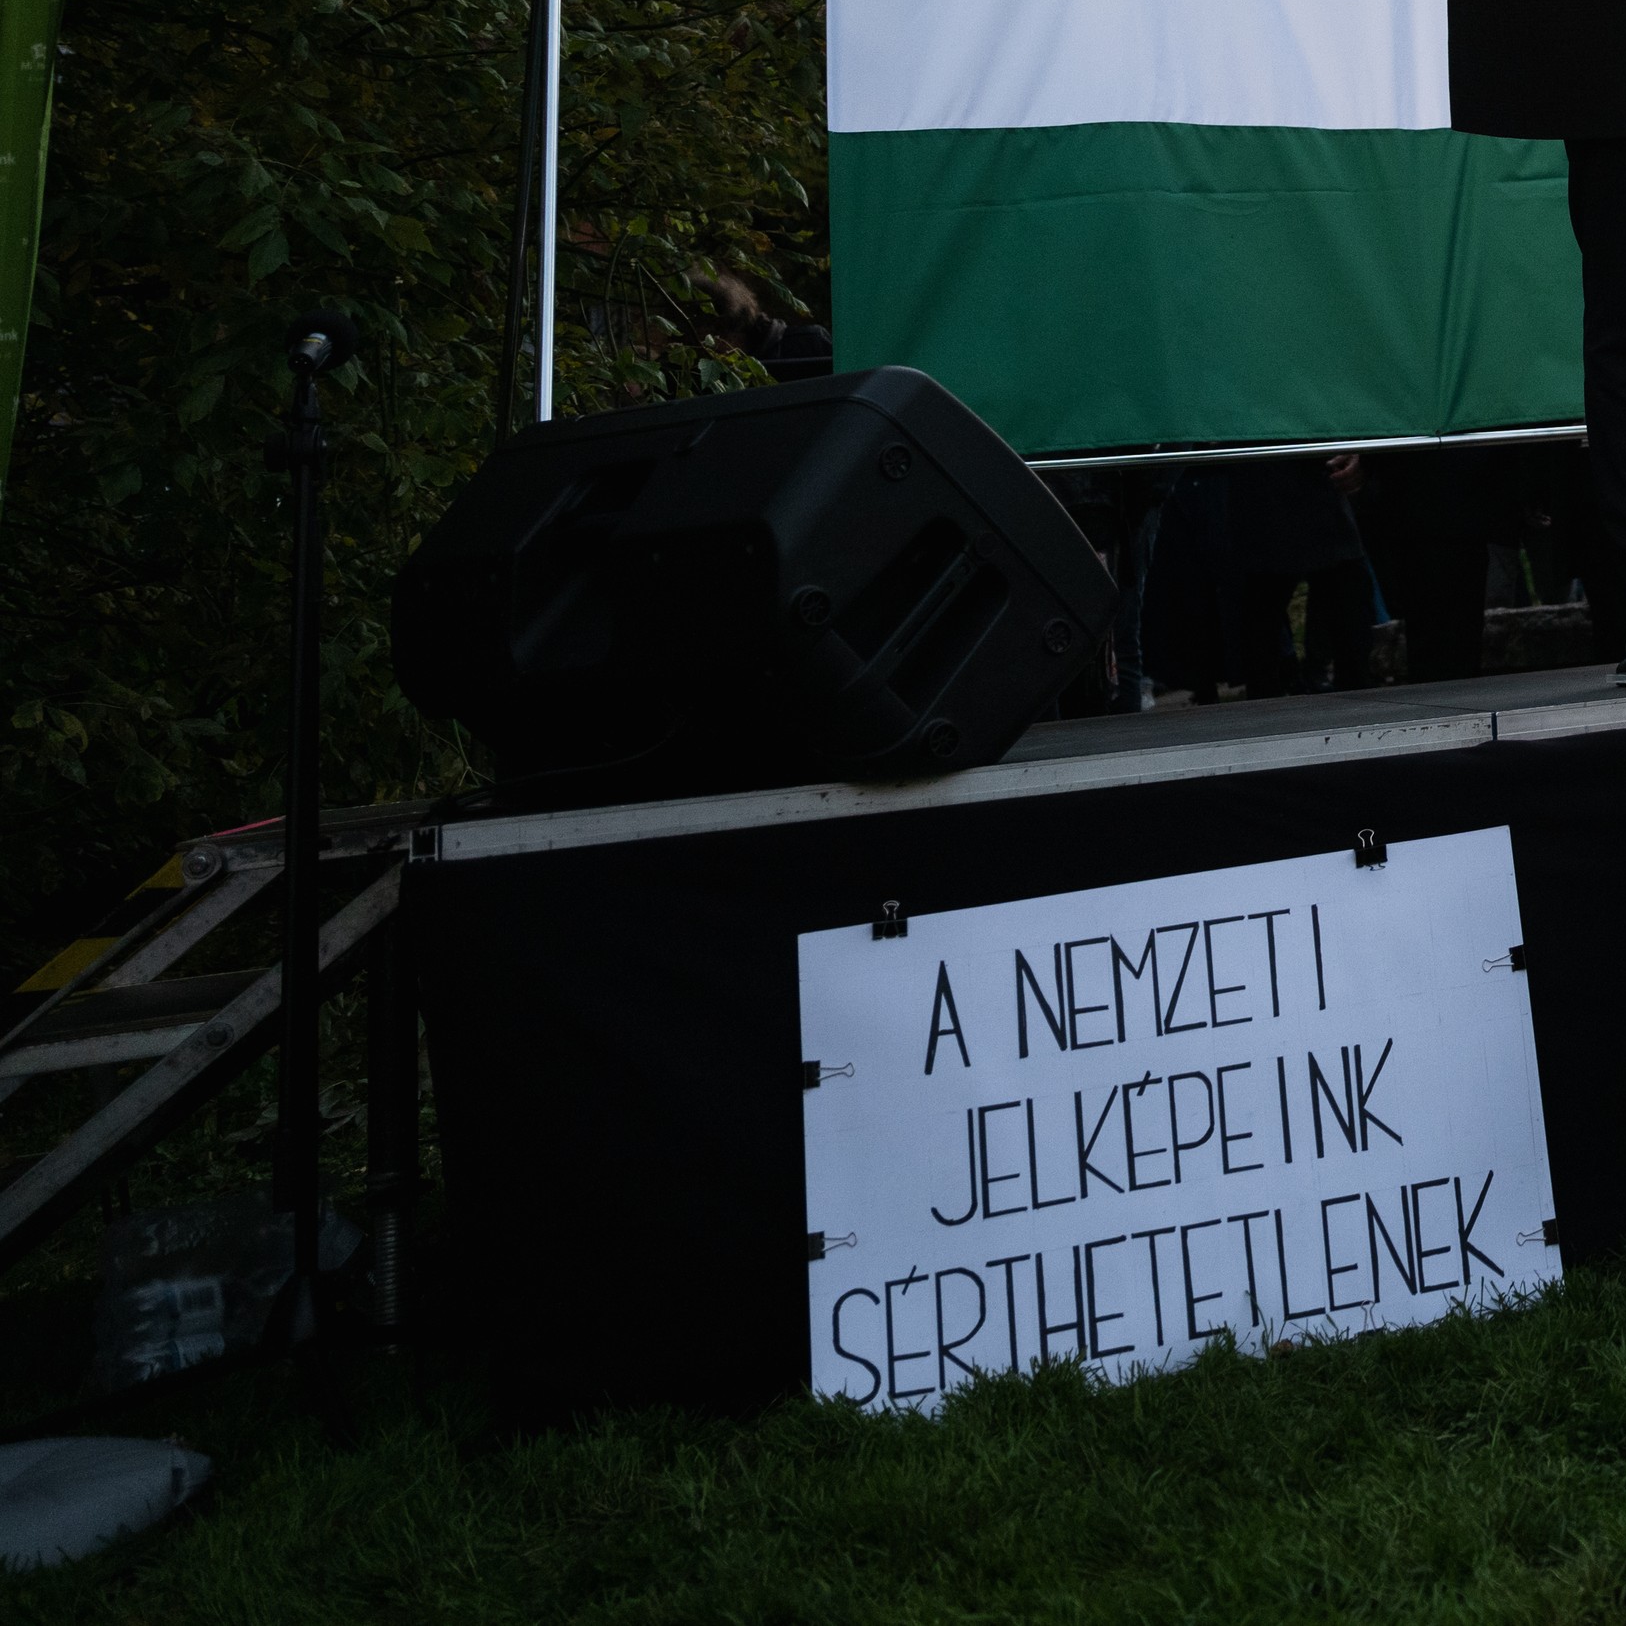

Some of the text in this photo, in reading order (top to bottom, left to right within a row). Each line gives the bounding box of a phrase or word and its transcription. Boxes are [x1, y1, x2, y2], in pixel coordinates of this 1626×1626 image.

[924, 903, 1327, 1076] A NEMZETI
[930, 1037, 1404, 1227] JELKÉPEINK
[831, 1169, 1506, 1406] SÉRTHETETLENEK
